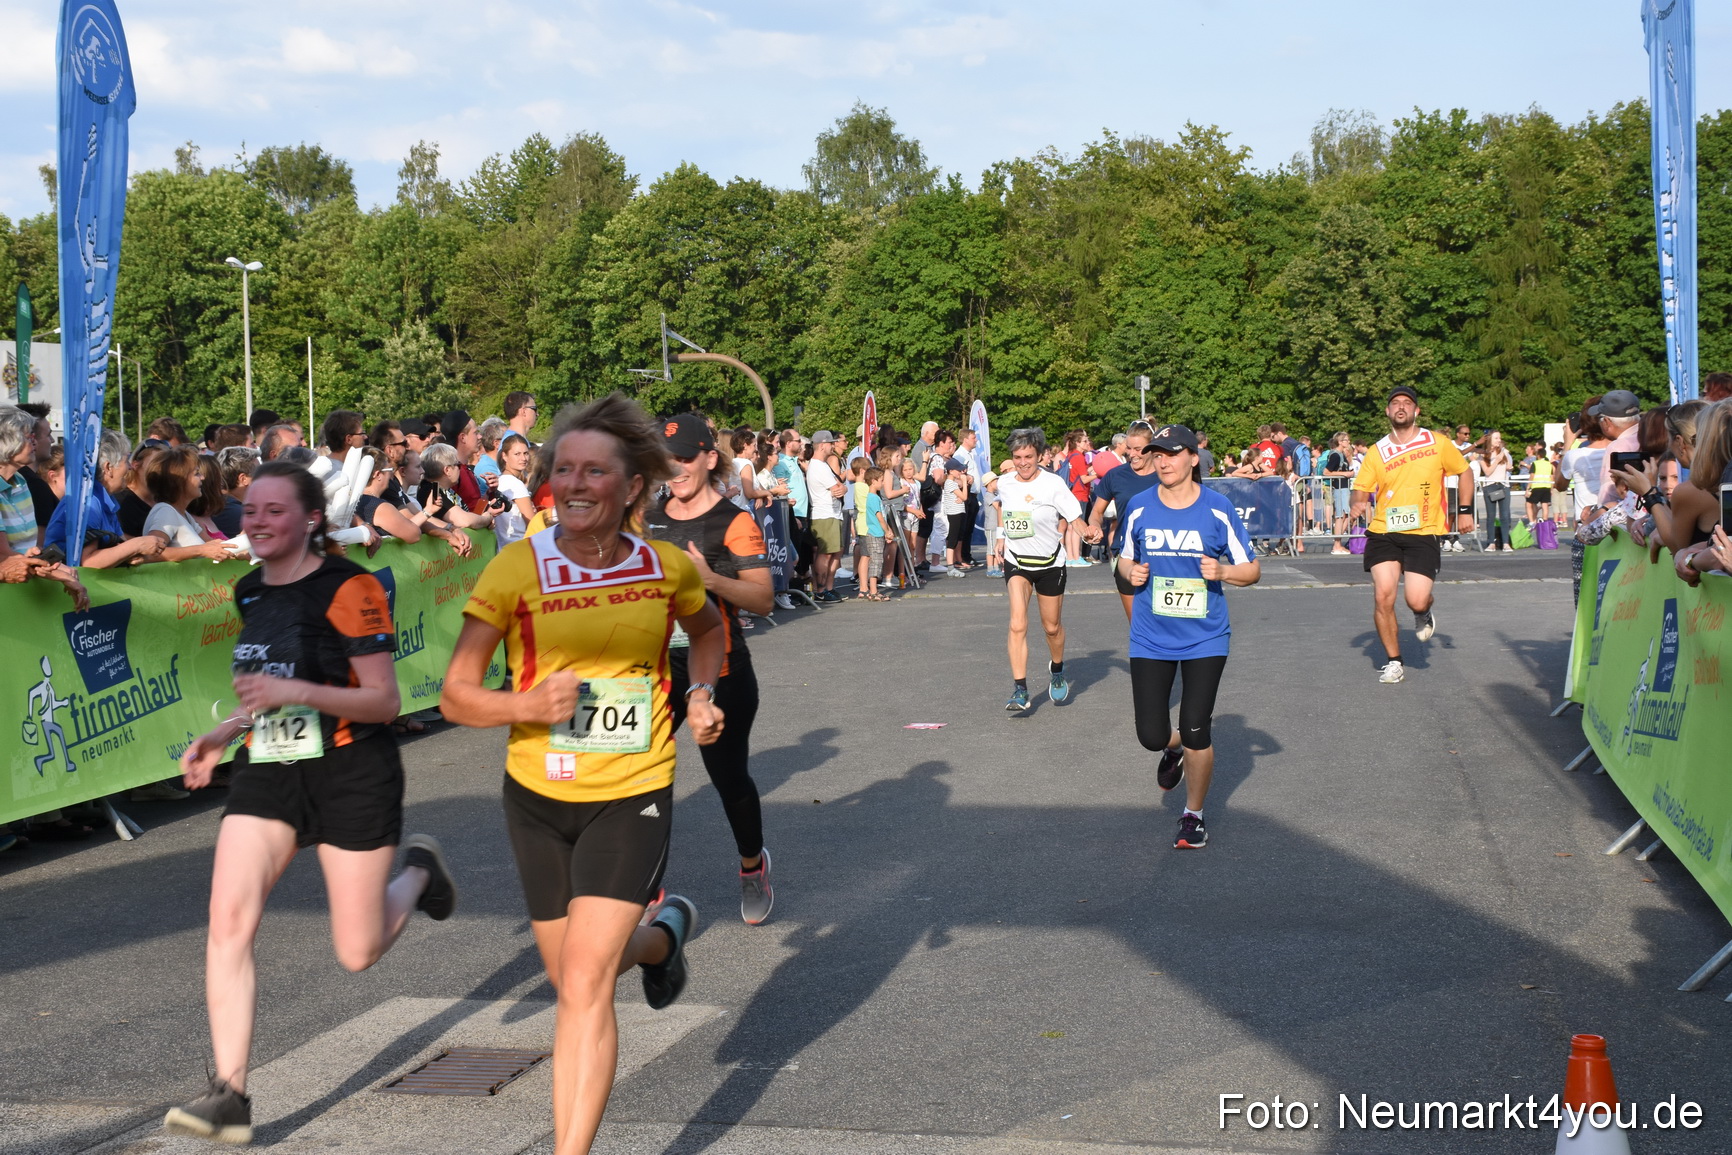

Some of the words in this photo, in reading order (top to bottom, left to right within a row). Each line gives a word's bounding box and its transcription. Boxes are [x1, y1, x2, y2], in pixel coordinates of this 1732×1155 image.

[1385, 458, 1407, 473] MAX
[1410, 448, 1438, 462] BÖGL
[1005, 520, 1029, 530] 1329
[1390, 514, 1416, 525] 1705
[1144, 528, 1204, 551] DVA
[176, 577, 234, 620] Gesunde
[542, 595, 600, 615] MAX
[607, 587, 668, 605] BÖGL
[1164, 591, 1195, 607] 677
[79, 628, 118, 651] Fischer
[87, 642, 115, 658] AUTOMOBILE
[69, 653, 182, 742] firmenlauf
[82, 726, 136, 763] neumarkt
